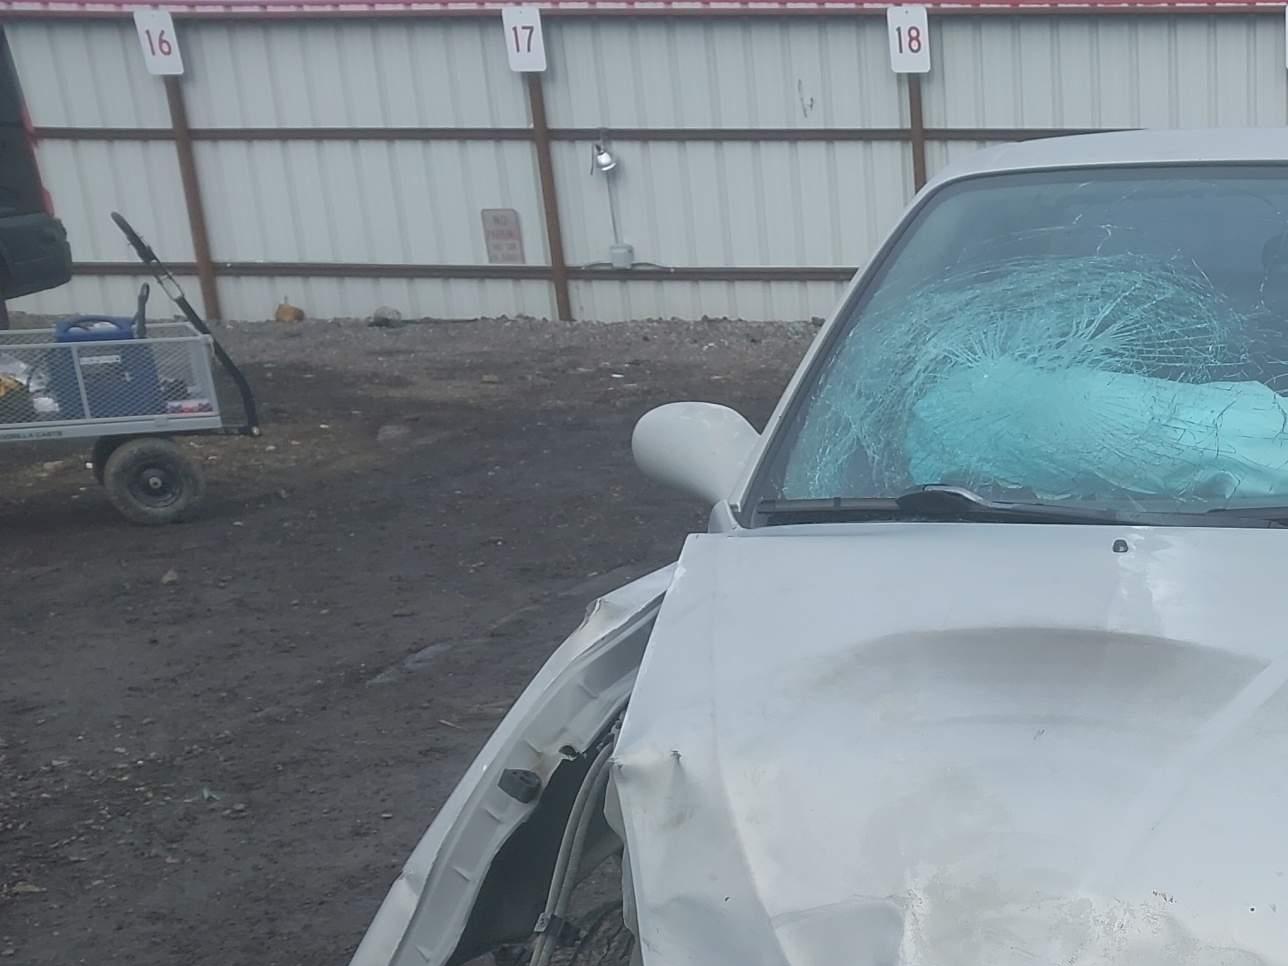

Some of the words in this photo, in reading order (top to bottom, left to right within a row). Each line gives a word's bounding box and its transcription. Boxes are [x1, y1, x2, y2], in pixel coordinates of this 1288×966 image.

[145, 29, 172, 57] 16
[511, 25, 535, 53] 17
[895, 25, 922, 54] 18
